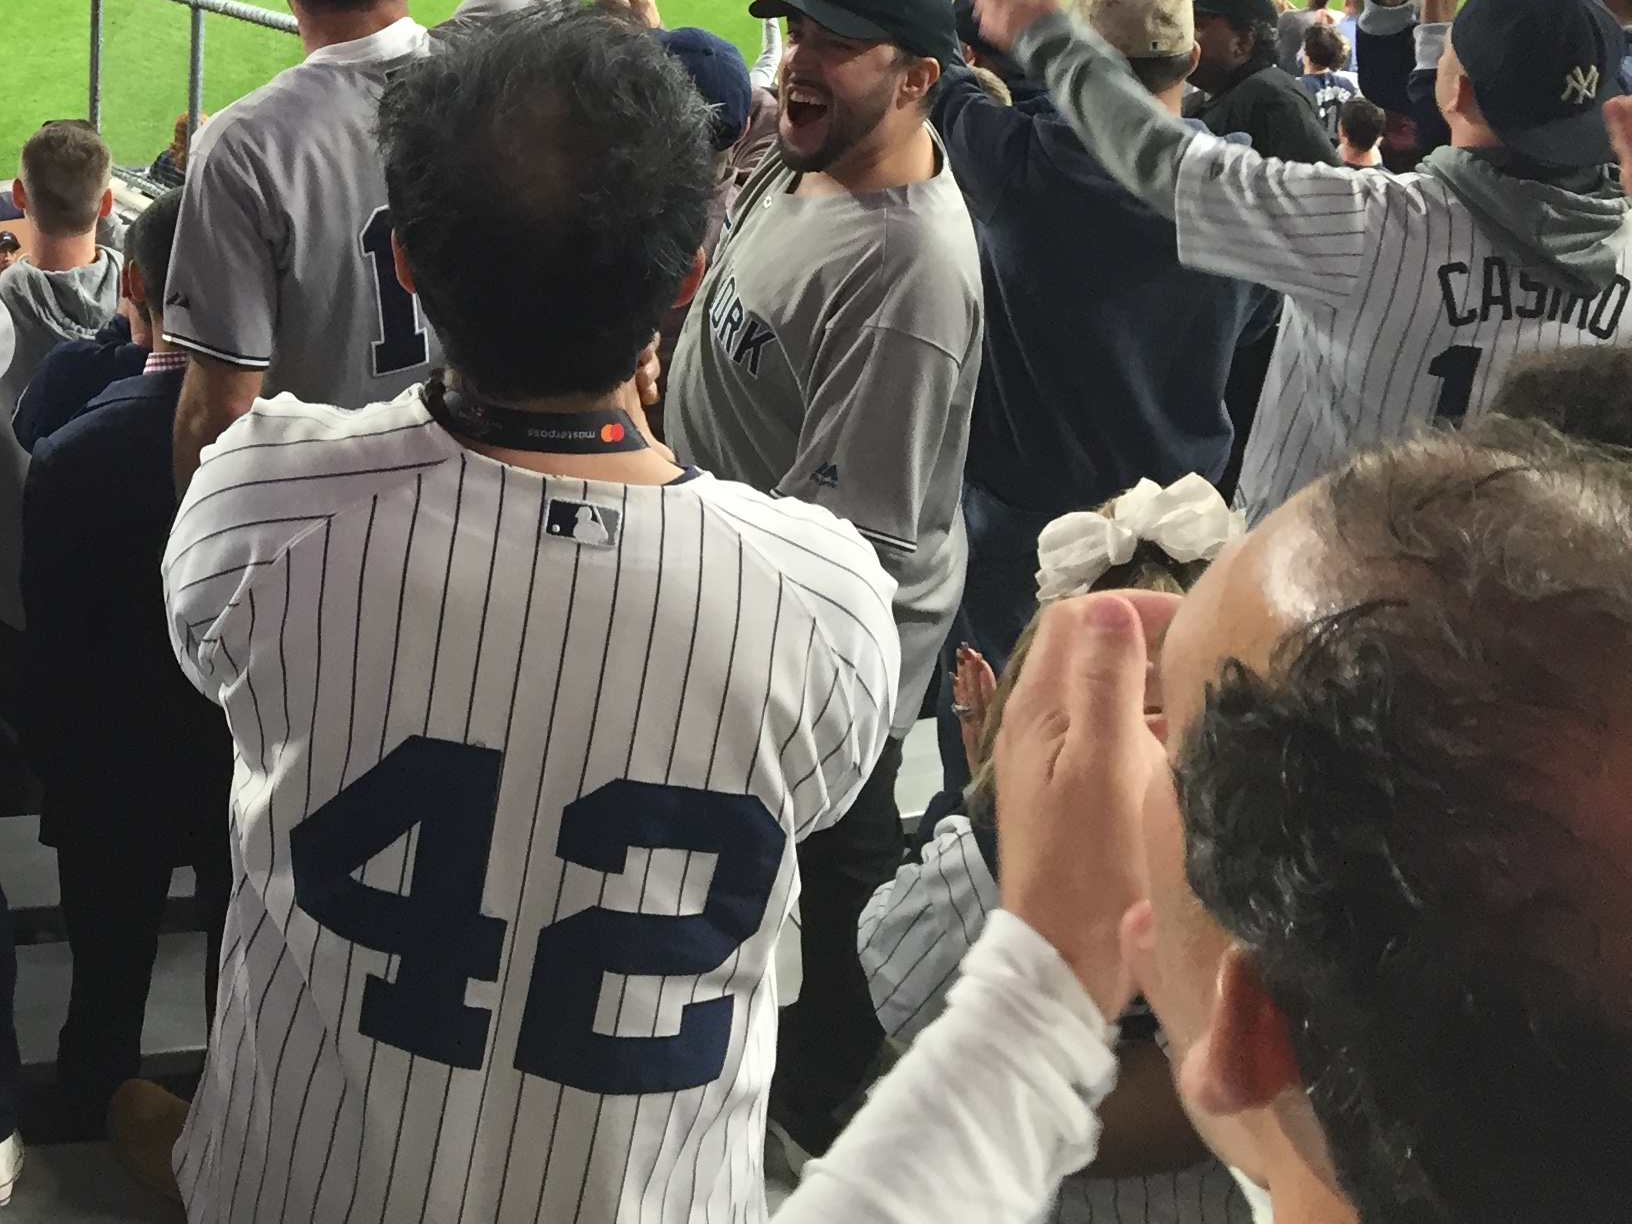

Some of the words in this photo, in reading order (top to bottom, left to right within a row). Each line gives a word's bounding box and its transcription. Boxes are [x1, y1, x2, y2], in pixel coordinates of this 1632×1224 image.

[1560, 64, 1600, 106] NY
[709, 275, 776, 379] ORK
[526, 428, 596, 441] masterpass
[289, 734, 787, 1096] 42
